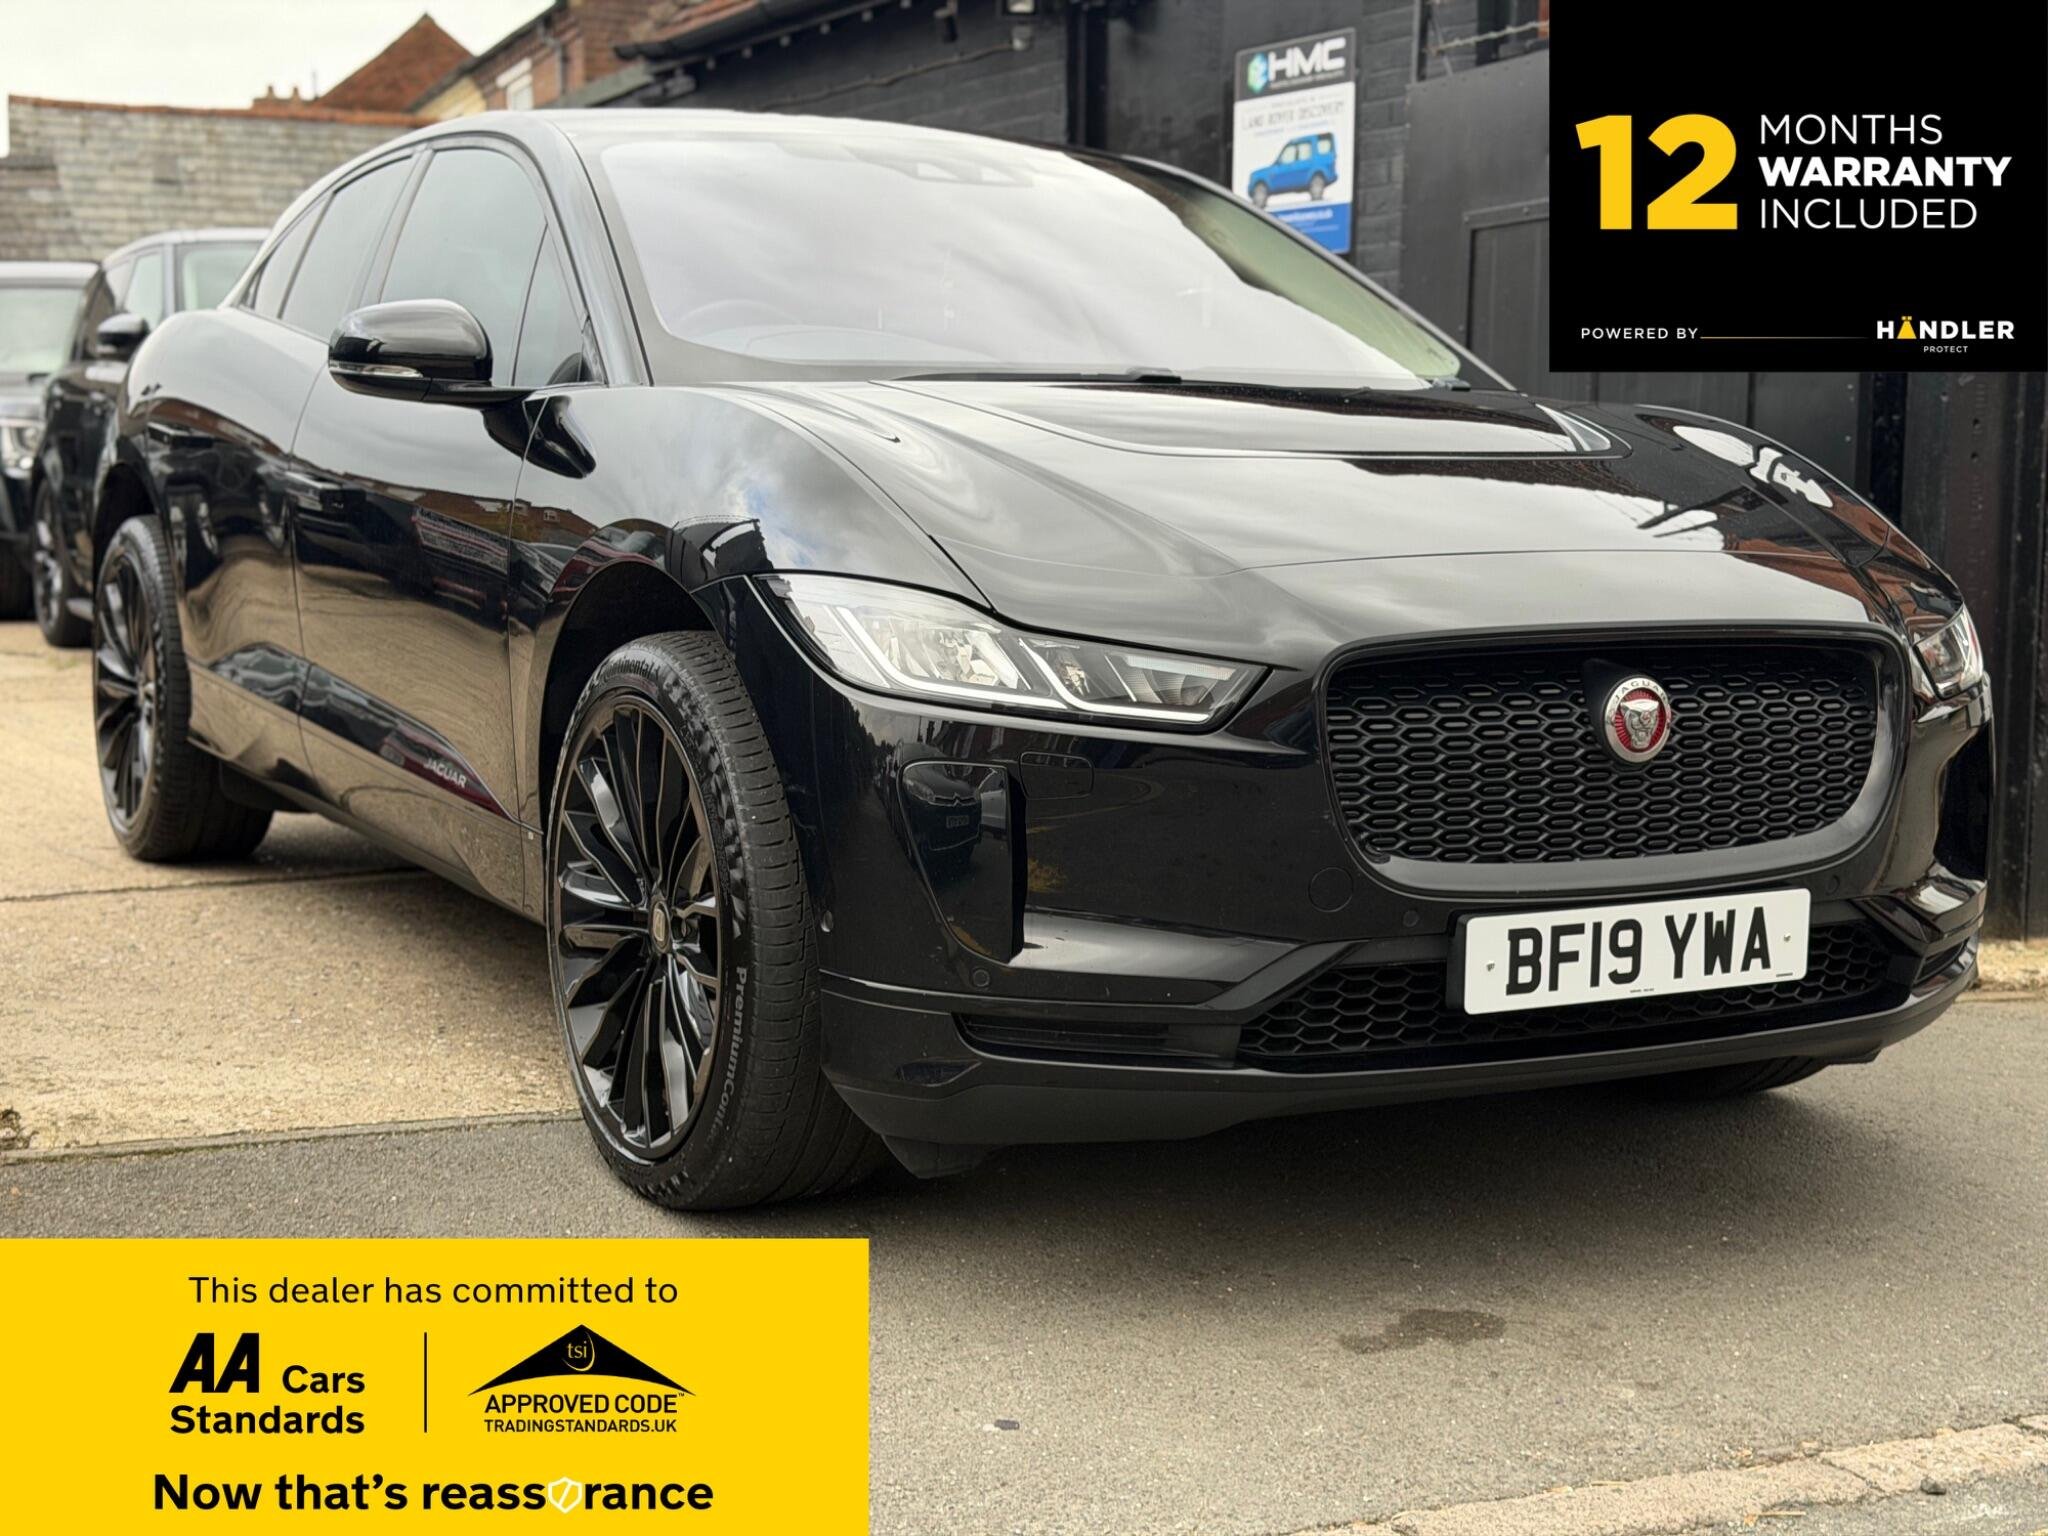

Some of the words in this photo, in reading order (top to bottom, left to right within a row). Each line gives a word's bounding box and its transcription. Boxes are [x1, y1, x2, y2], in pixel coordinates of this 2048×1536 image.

[1268, 37, 1346, 81] HMC
[1615, 680, 1668, 701] JAGUAR
[422, 758, 467, 788] JAGUAR
[1505, 918, 1643, 996] BF19
[1664, 906, 1772, 980] YWA
